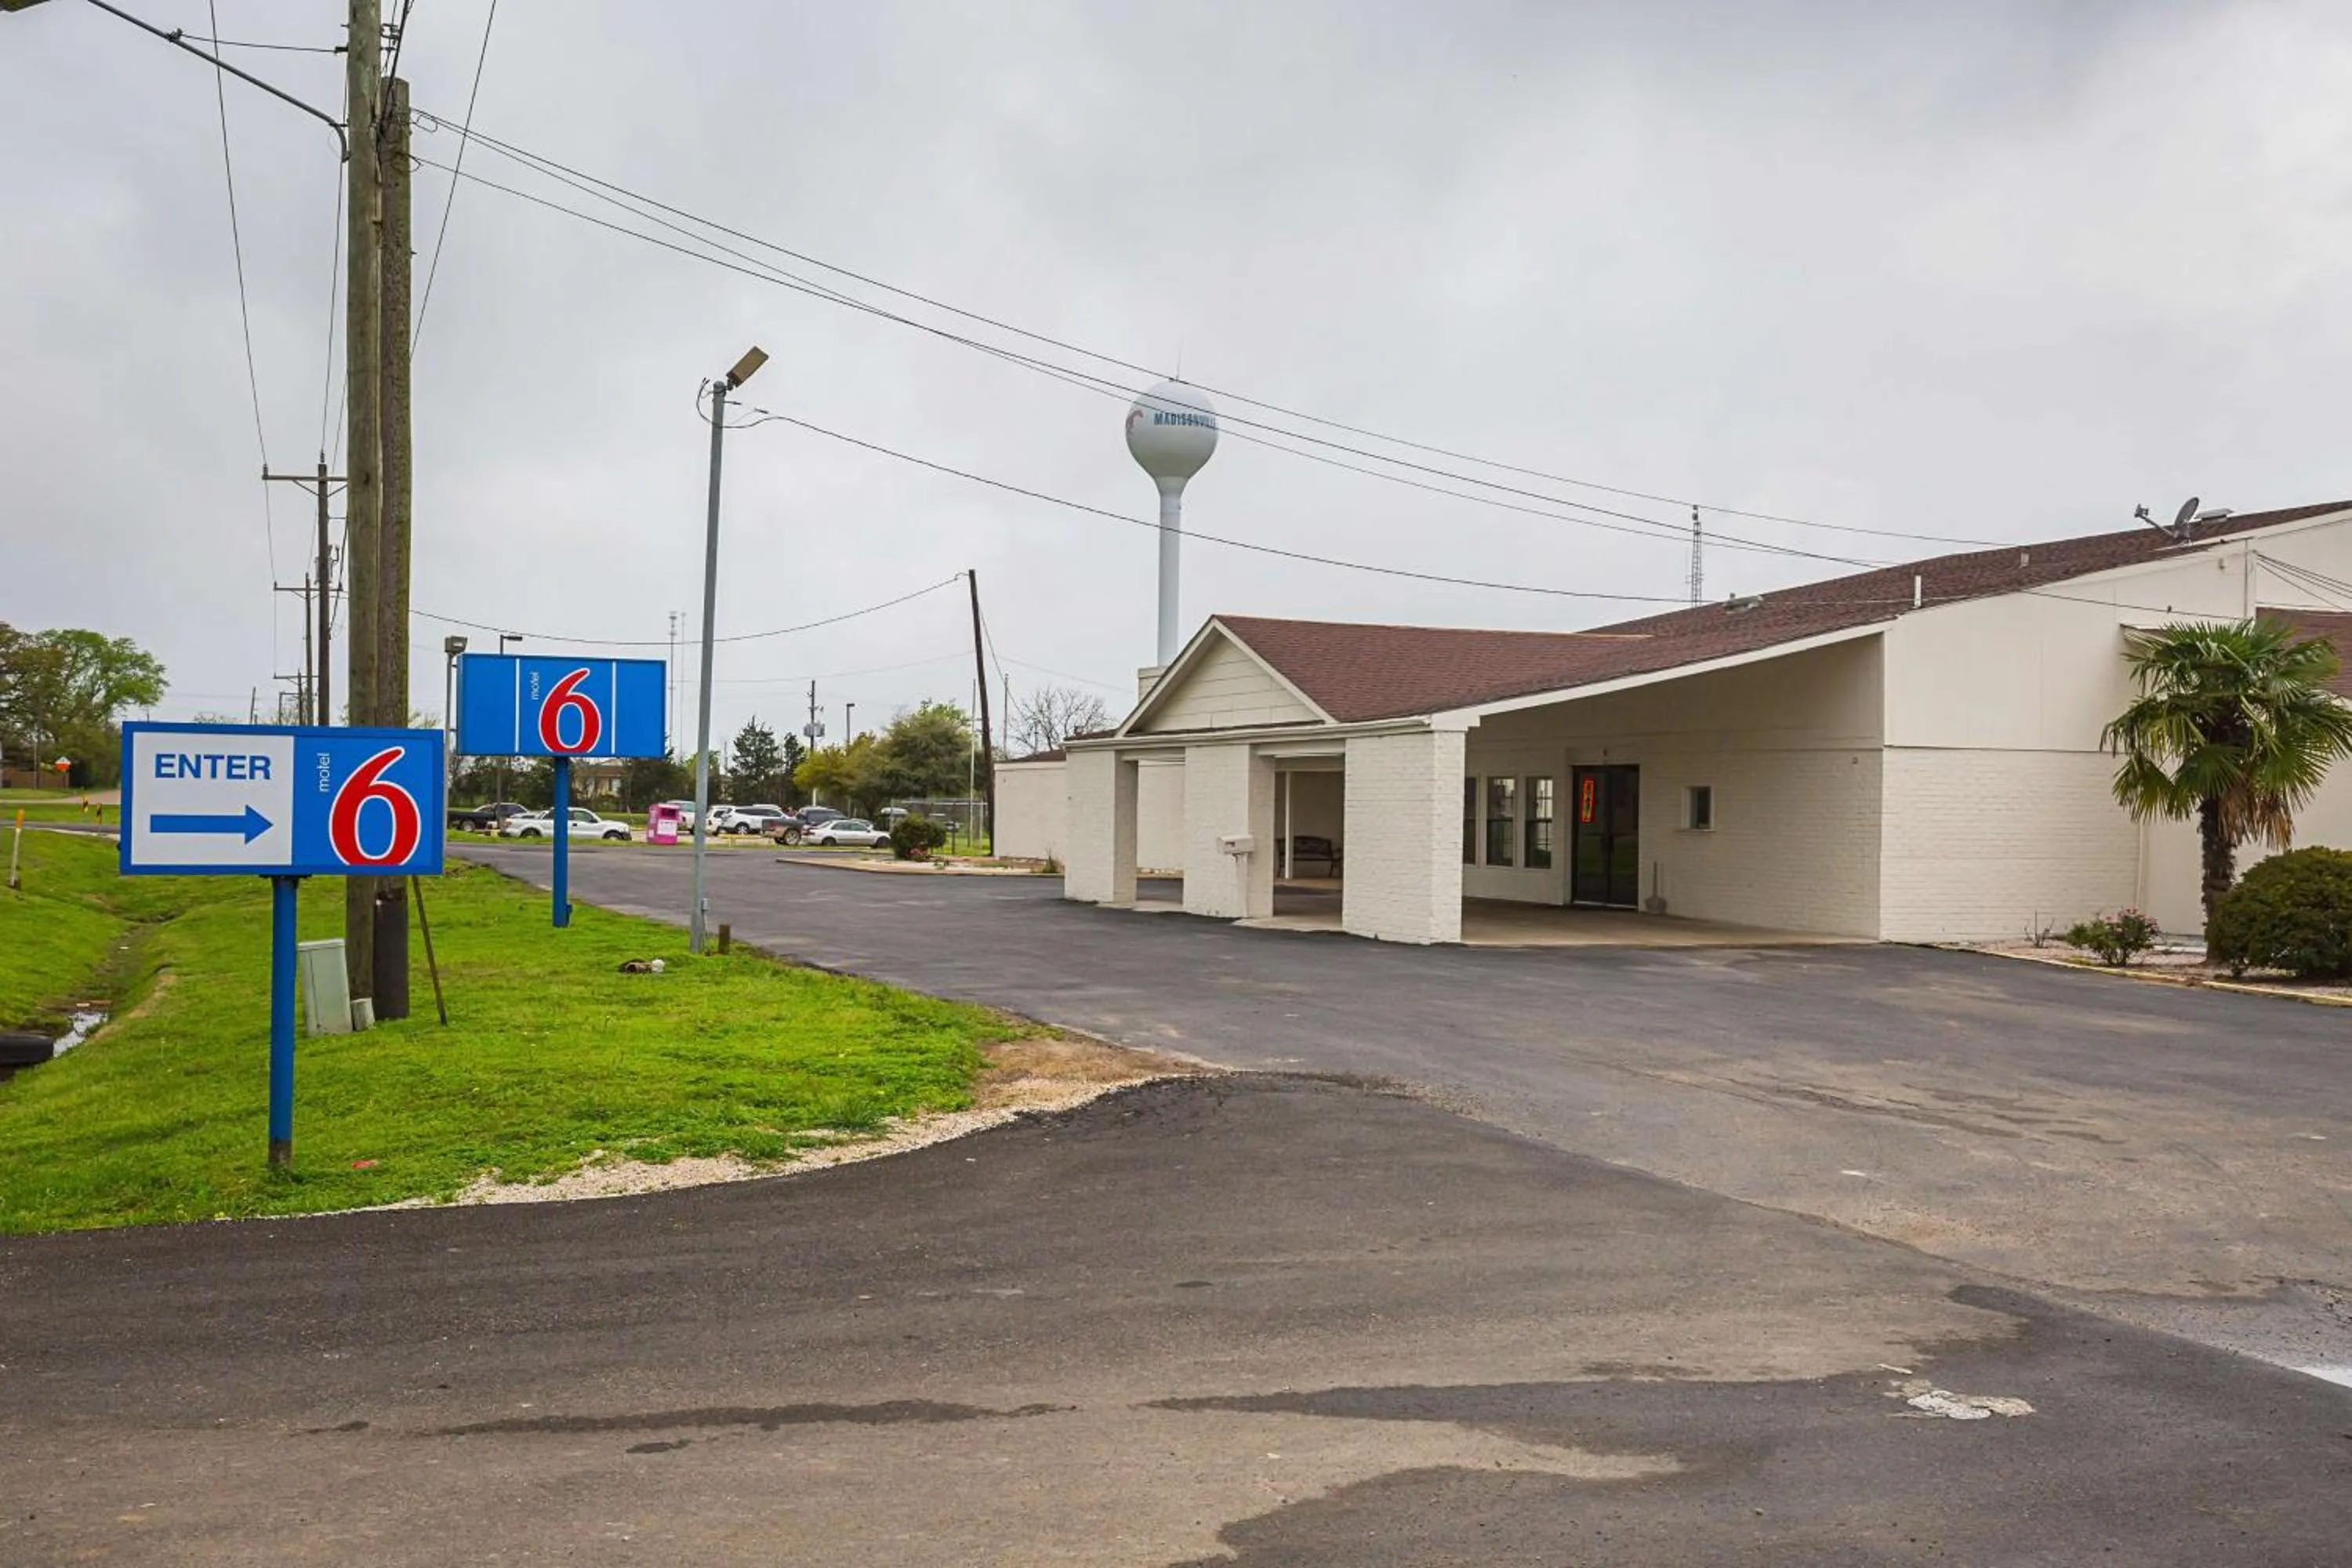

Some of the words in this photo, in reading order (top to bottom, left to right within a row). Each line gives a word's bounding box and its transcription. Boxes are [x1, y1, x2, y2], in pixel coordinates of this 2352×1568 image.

[530, 672, 540, 700] motel
[539, 667, 601, 753] 6
[154, 753, 271, 780] ENTER
[317, 753, 330, 792] motel
[328, 746, 422, 866] 6
